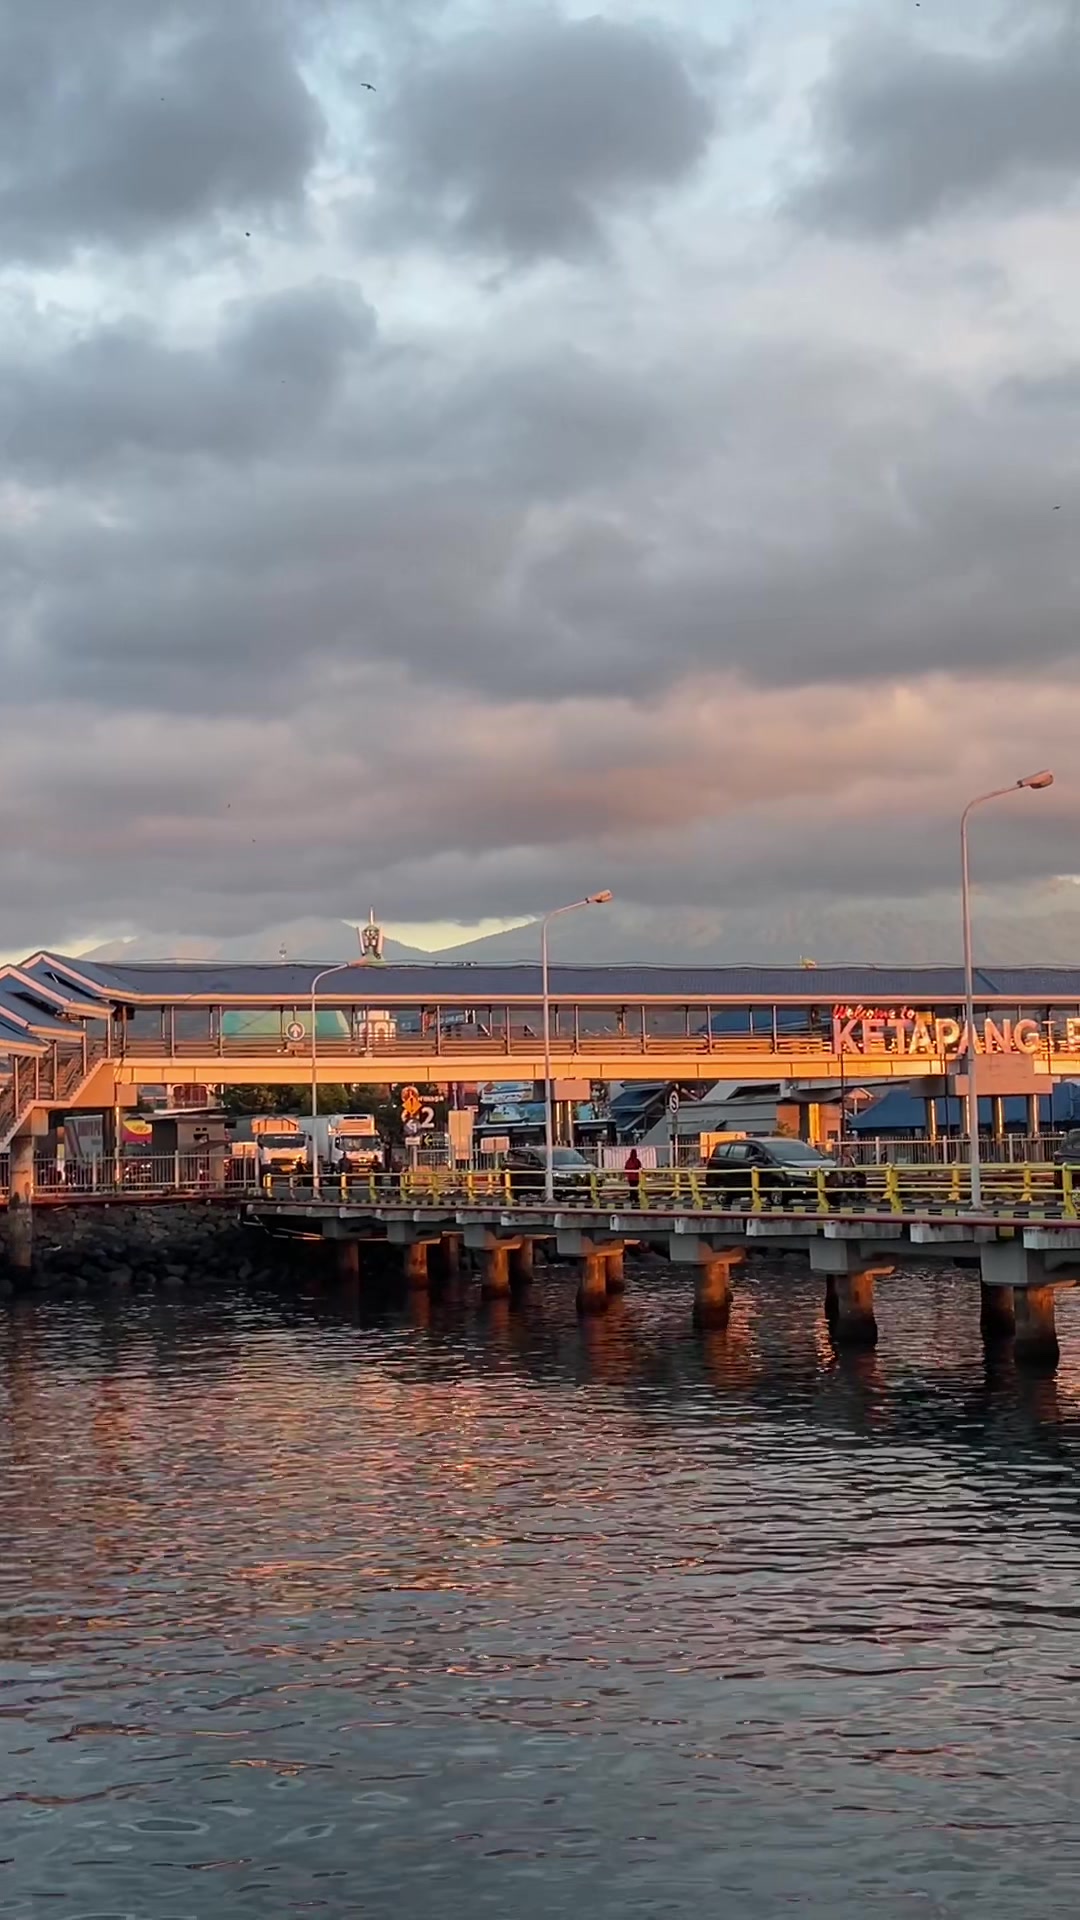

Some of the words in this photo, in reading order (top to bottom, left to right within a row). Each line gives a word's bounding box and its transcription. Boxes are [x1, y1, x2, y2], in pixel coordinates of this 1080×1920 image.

[833, 1004, 896, 1019] Welcome
[900, 1005, 915, 1019] to
[833, 1017, 1040, 1055] KETAPANG
